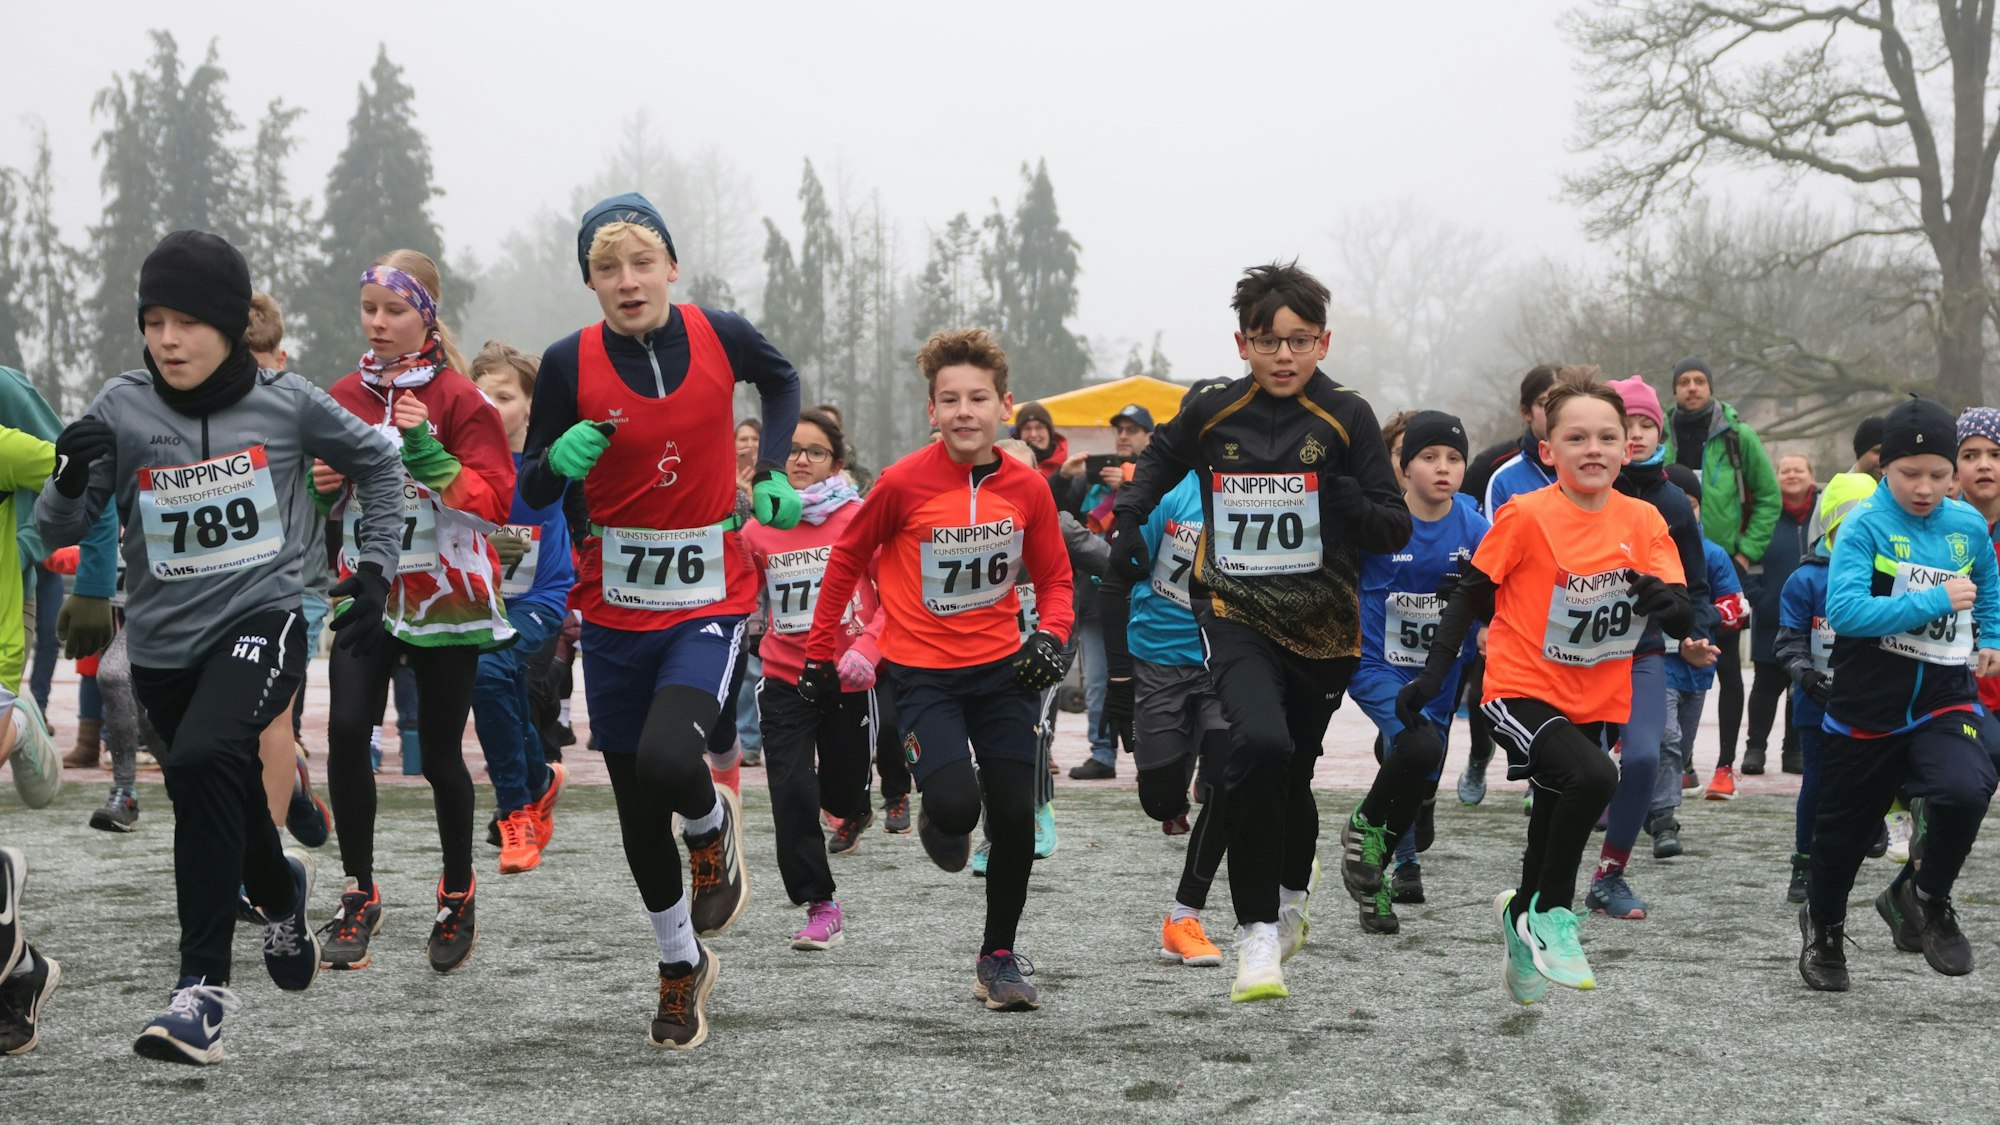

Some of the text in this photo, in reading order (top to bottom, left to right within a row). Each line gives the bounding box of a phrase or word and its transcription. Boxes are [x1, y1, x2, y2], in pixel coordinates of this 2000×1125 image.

[150, 435, 181, 446] JAKO
[152, 455, 250, 490] KNIPPING
[155, 479, 255, 506] KUNSTSTOFFTECHNIK
[1222, 476, 1303, 494] KNIPPING
[1224, 499, 1305, 507] KUNSTSTOFFTECHNIK
[161, 497, 259, 554] 789
[933, 520, 1012, 544] KNIPPING
[1182, 520, 1203, 529] JAKO
[1228, 512, 1304, 550] 770
[616, 530, 708, 541] KUNSTSTOFFTECHNIK
[768, 547, 830, 569] KNIPPING
[933, 540, 1011, 556] KUNSTSTOFFTECHNIK
[1392, 554, 1413, 562] JAKO
[195, 550, 278, 574] Fahrzeugtechnik
[621, 544, 705, 585] 776
[1246, 562, 1316, 571] Fahrzeugtechnik
[938, 552, 1008, 594] 716
[1568, 601, 1632, 644] 769
[236, 636, 268, 645] JAKO
[231, 643, 260, 663] HA
